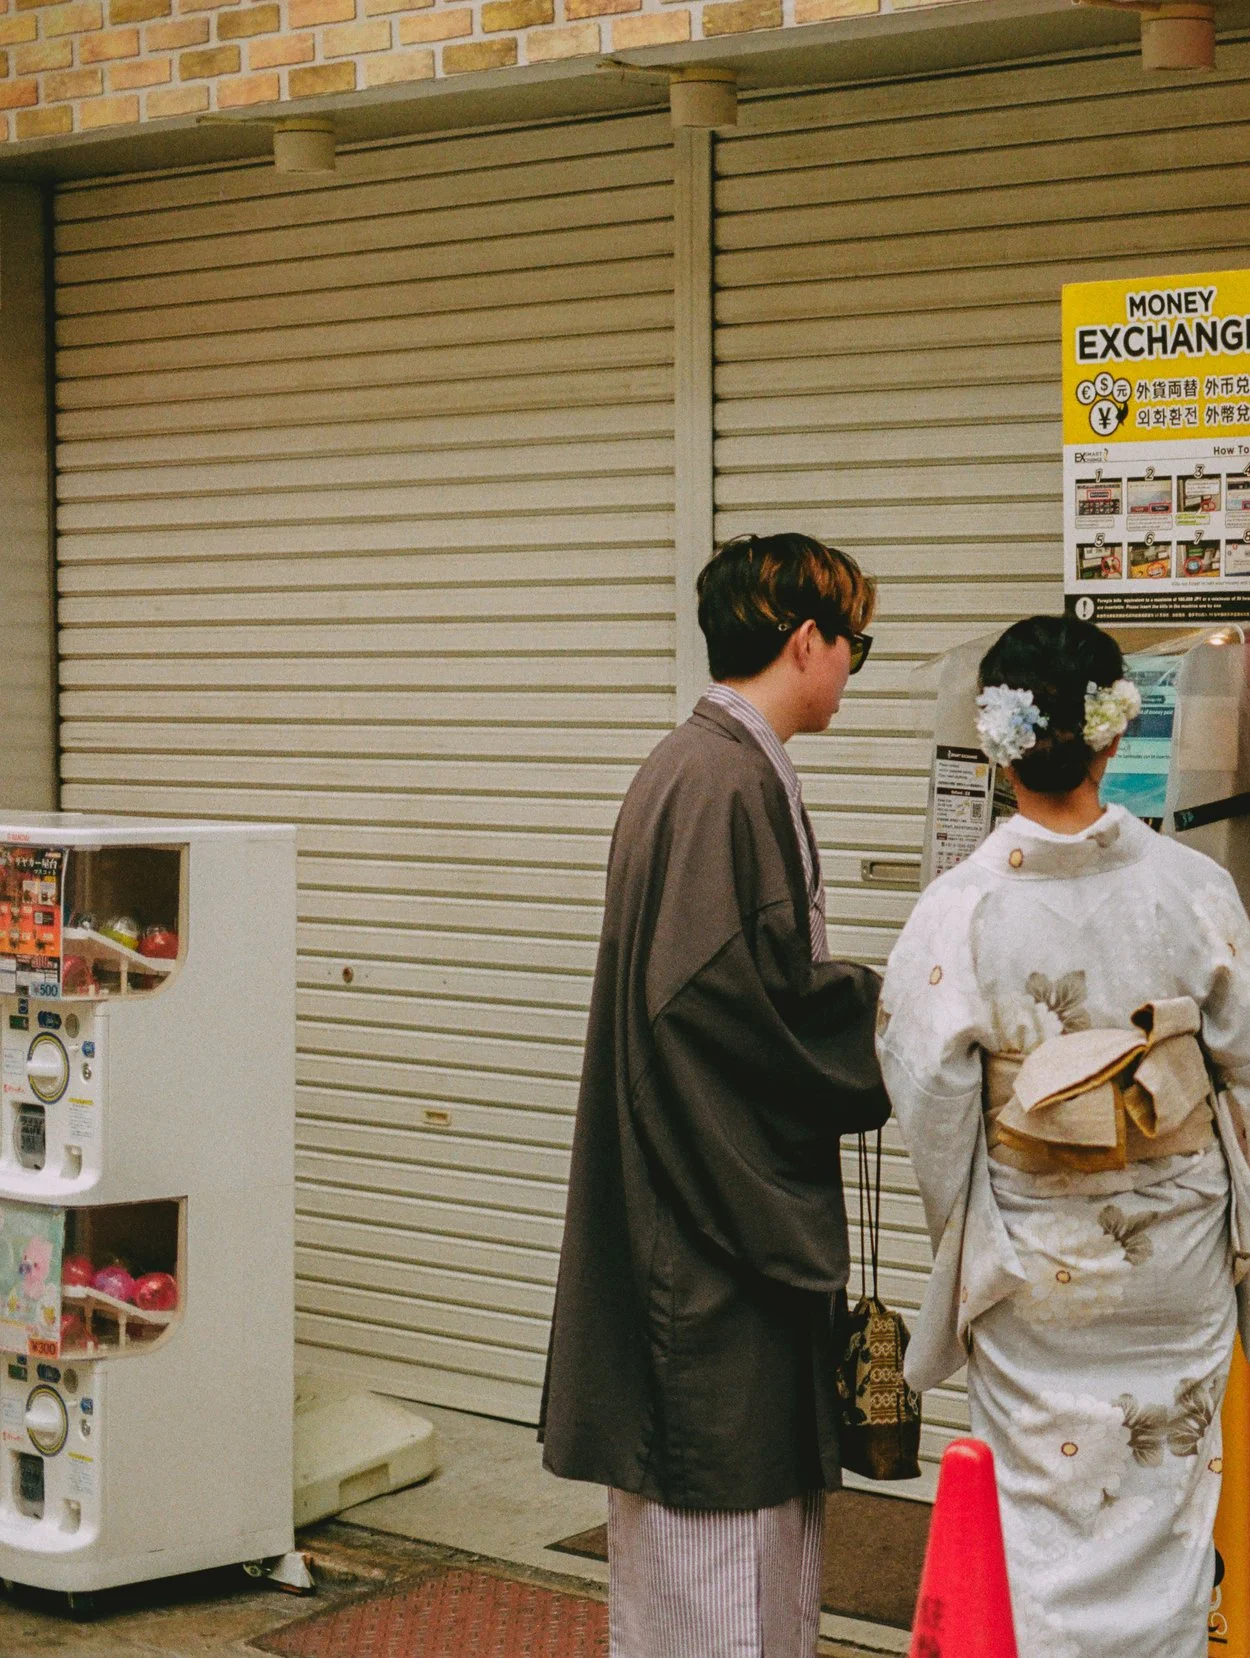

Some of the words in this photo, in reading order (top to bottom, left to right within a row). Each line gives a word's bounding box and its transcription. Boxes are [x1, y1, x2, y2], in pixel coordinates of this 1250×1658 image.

[1129, 290, 1214, 317] MONEY
[1136, 379, 1198, 399] 外貨両替
[1137, 406, 1197, 427] 외화환전
[1214, 446, 1234, 455] How
[1238, 445, 1249, 455] To
[1095, 470, 1102, 482] 1
[1145, 468, 1154, 480] 2
[1195, 465, 1204, 478] 3
[1095, 533, 1104, 546] 5
[1145, 532, 1154, 545] 6
[1195, 531, 1203, 544] 7
[32, 984, 58, 997] ¥500
[30, 1341, 56, 1355] ¥300
